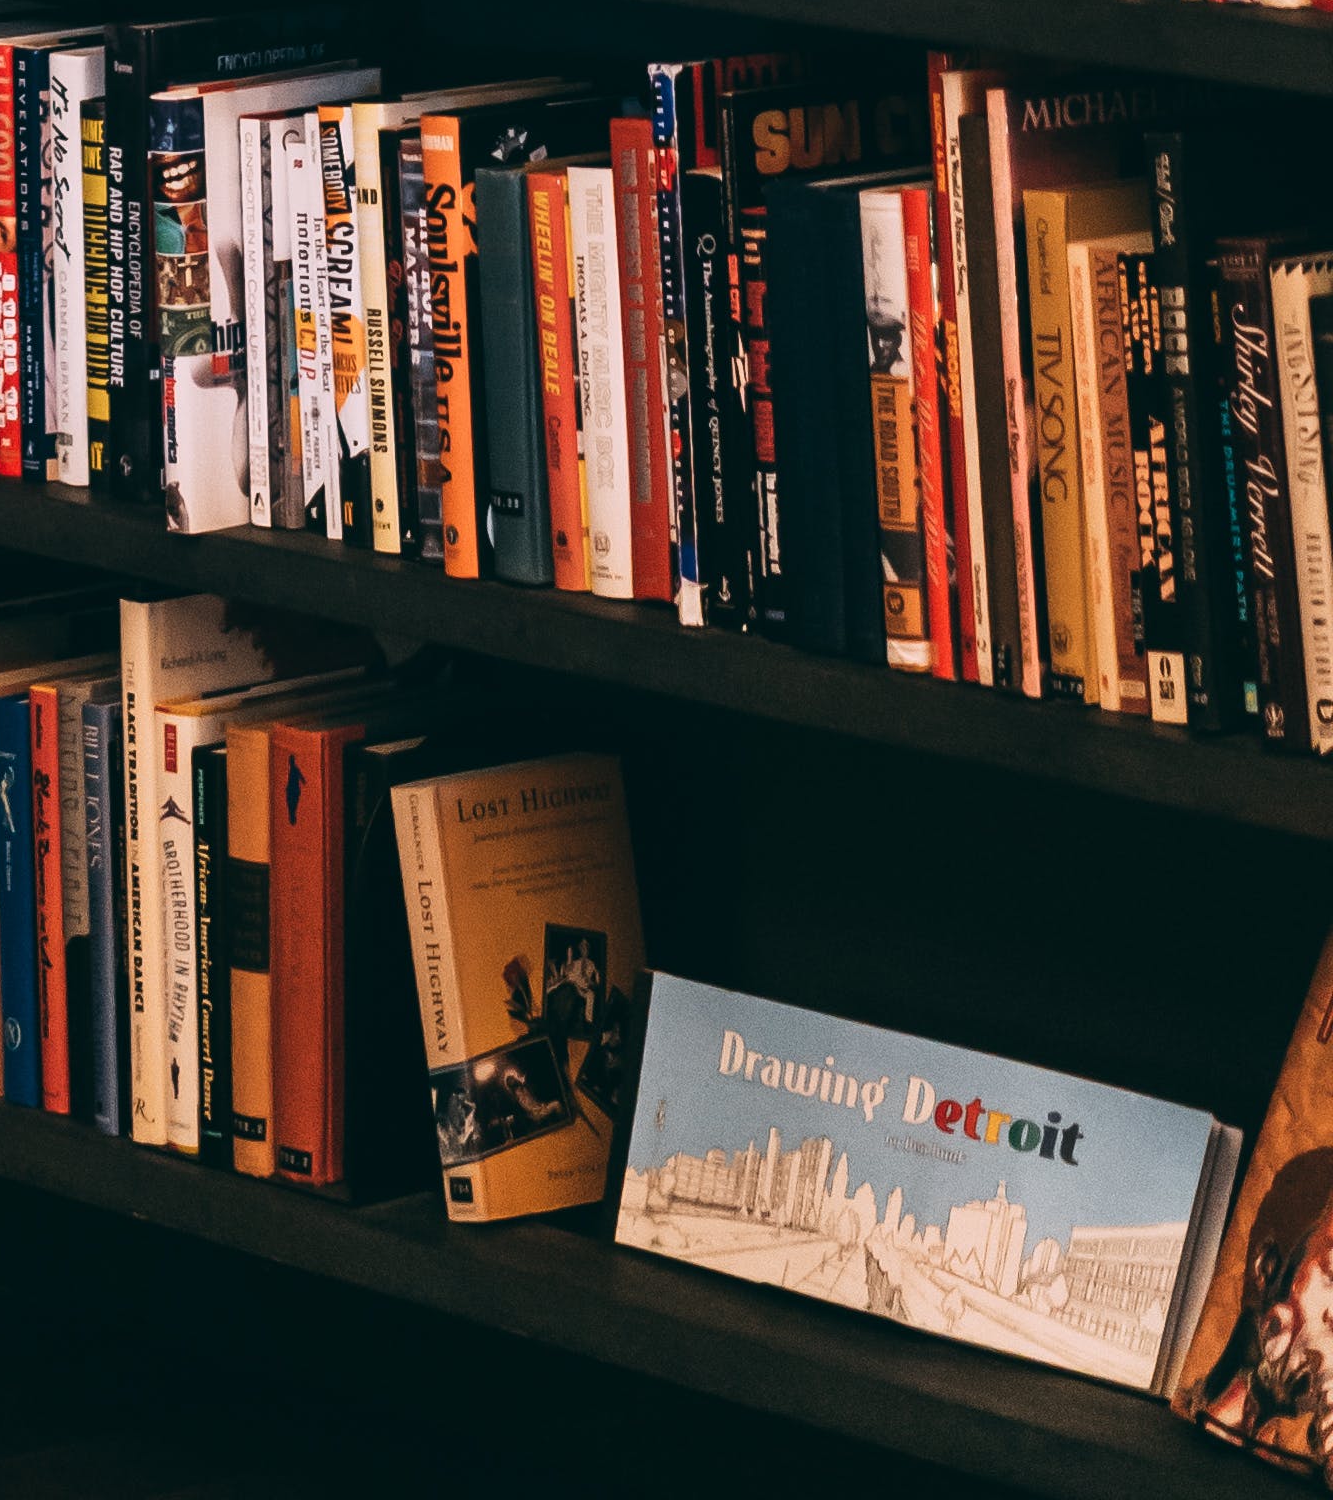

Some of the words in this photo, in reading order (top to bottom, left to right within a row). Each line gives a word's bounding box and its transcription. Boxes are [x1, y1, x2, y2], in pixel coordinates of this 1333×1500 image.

[108, 147, 123, 182] RAP
[109, 187, 123, 224] AND
[109, 229, 123, 260] HIP
[128, 201, 143, 313] ENCYCLOPEDIA
[109, 265, 123, 303] HOP
[109, 308, 124, 386] CULTURE
[129, 319, 142, 340] OF
[368, 308, 384, 375] RUSSELL
[370, 379, 388, 453] SIMMONS
[718, 1030, 893, 1121] Drawing
[901, 1076, 1083, 1167] Detroit
